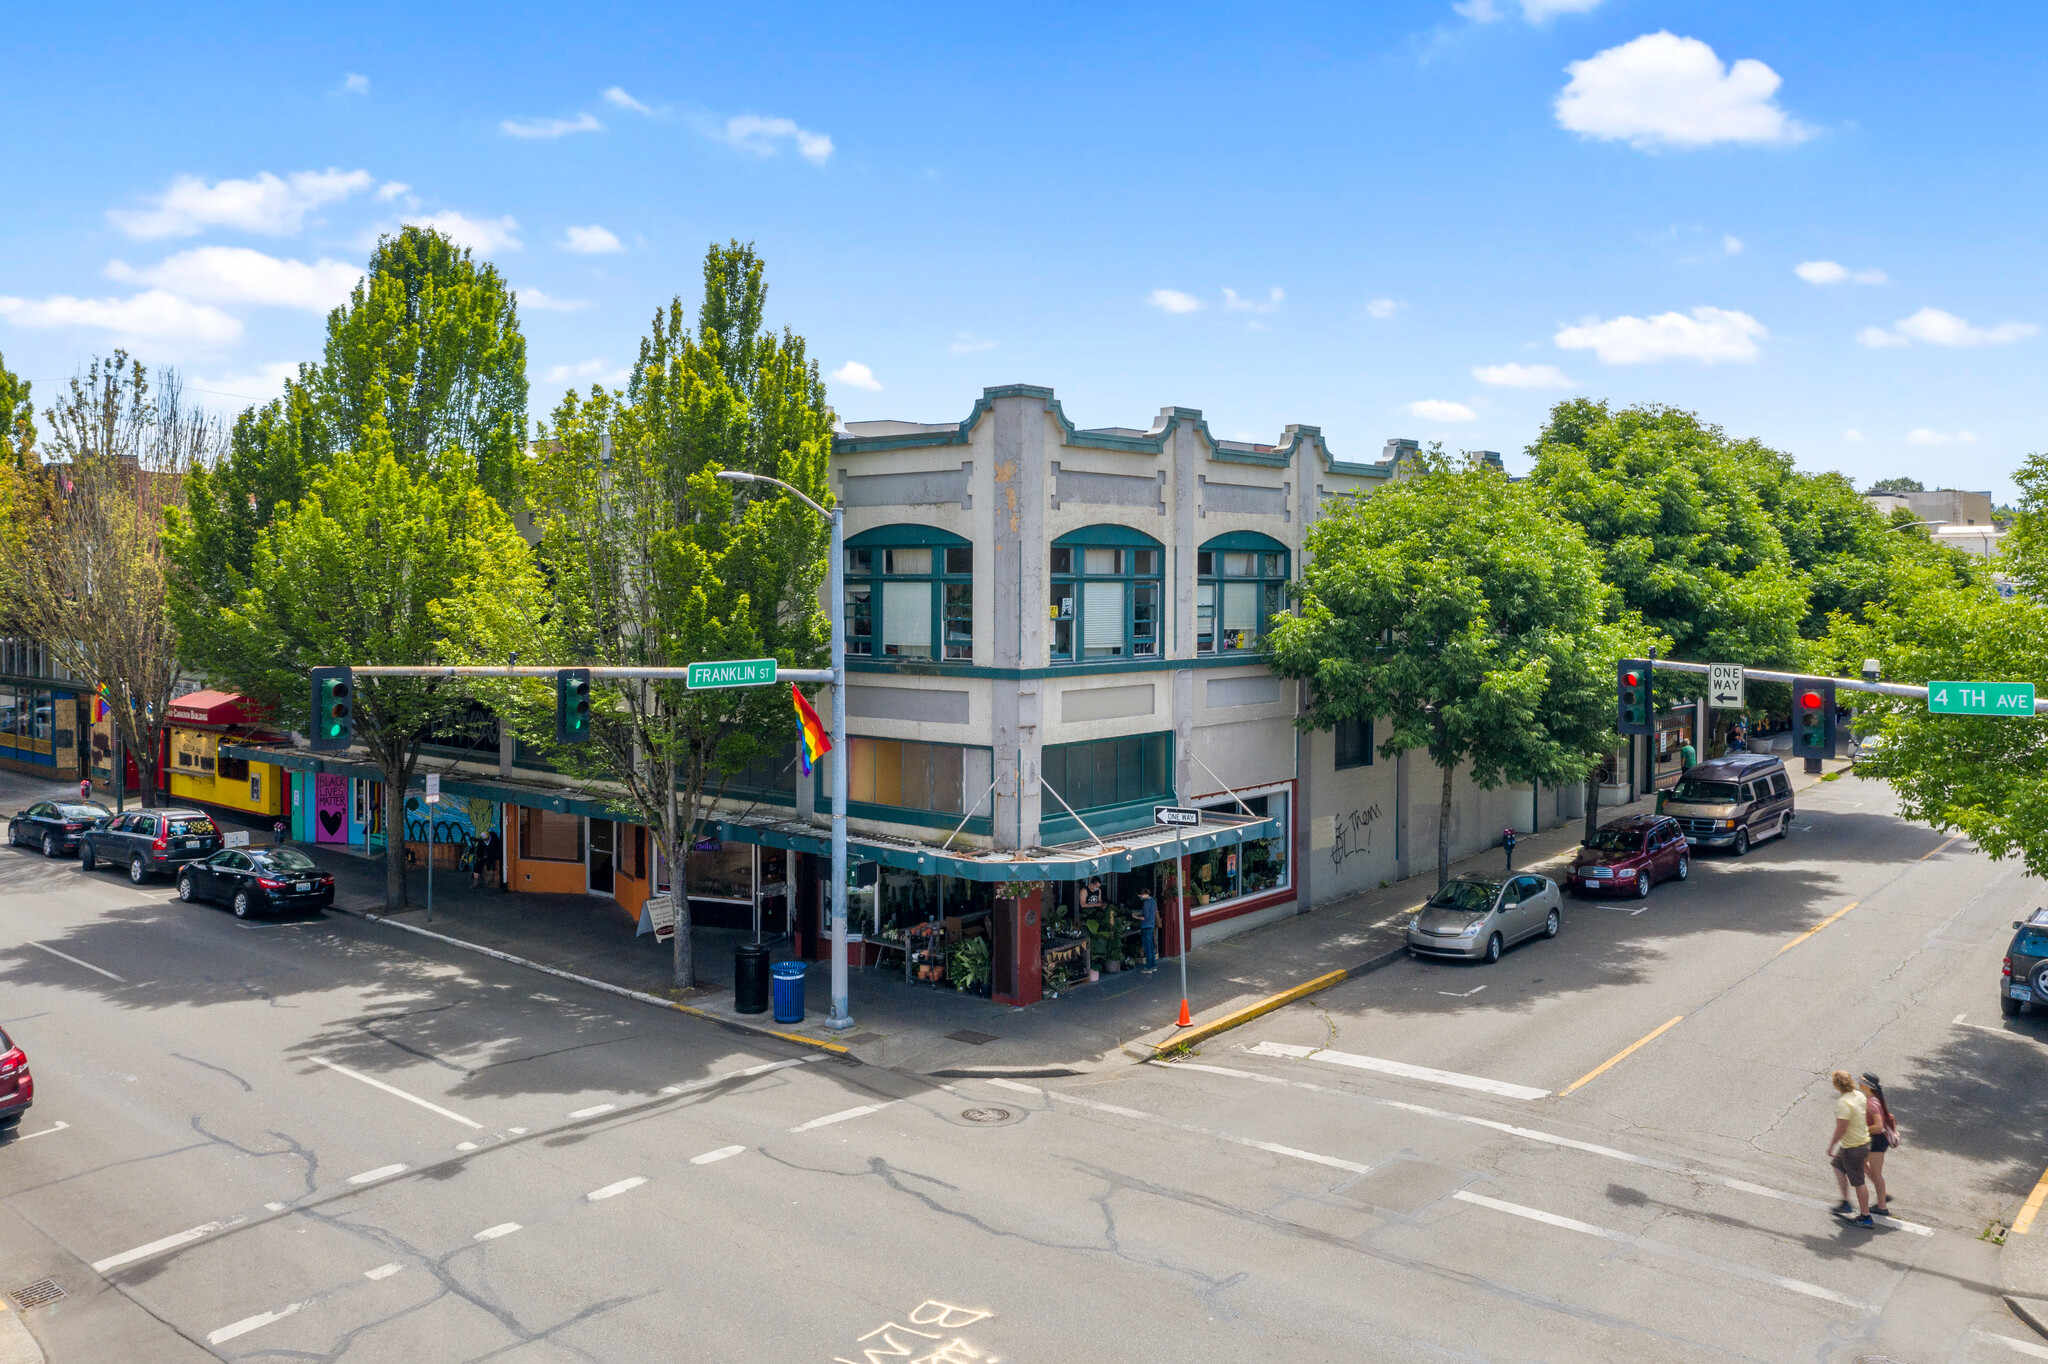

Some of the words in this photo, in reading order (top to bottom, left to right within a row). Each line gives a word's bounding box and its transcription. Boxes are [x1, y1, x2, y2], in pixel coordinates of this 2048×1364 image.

[695, 665, 755, 683] FRANKLIN
[759, 668, 770, 679] ST
[1714, 667, 1740, 679] ONE
[1713, 679, 1740, 691] WAY
[1934, 688, 1949, 706] 4
[1958, 689, 1986, 707] TH
[1996, 694, 2029, 709] AVE
[320, 776, 346, 788] BLACK
[320, 786, 344, 797] LIVES
[319, 796, 346, 807] MATTER
[1167, 812, 1180, 821] ONE
[1181, 814, 1195, 822] WAY
